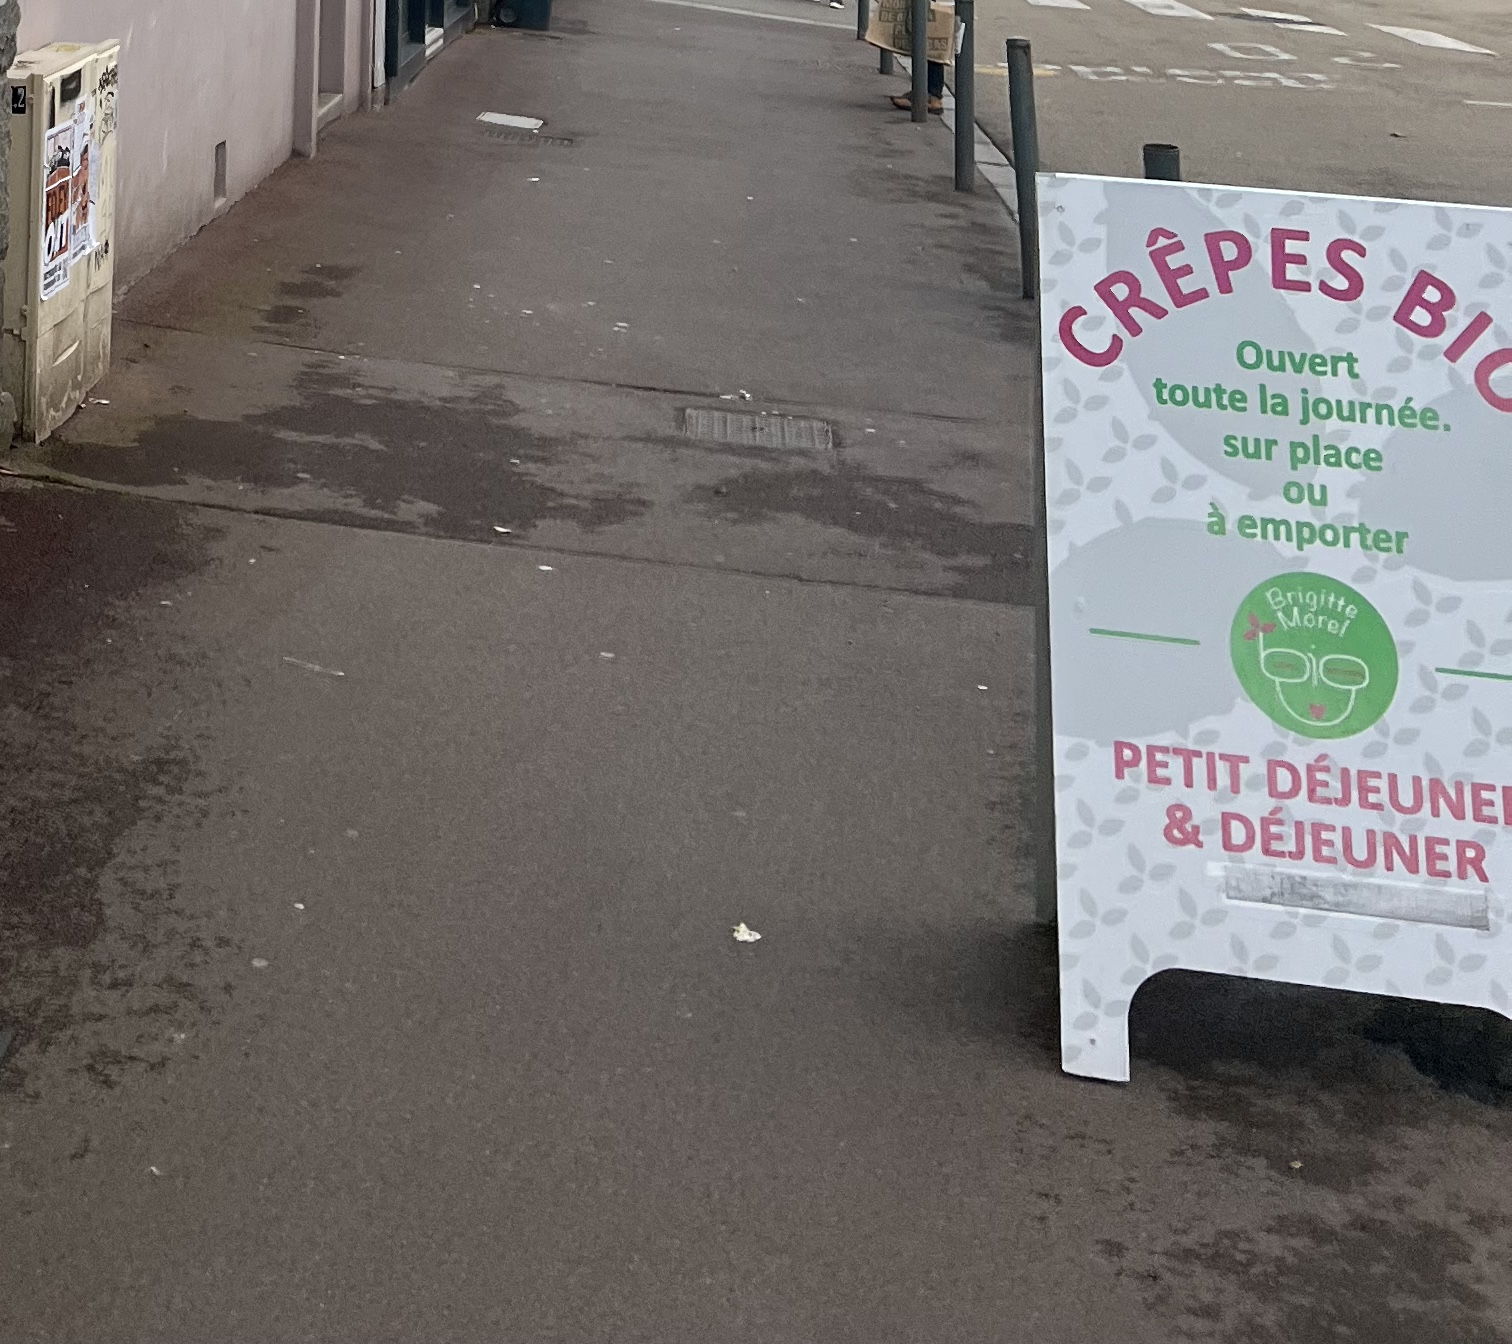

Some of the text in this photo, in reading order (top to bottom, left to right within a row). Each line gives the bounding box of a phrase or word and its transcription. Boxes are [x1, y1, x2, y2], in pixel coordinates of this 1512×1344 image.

[1058, 227, 1367, 368] CRÊPES
[1236, 340, 1360, 380] Ouvert
[1153, 378, 1451, 432] toute la journée.
[1223, 433, 1384, 473] sur place
[1282, 480, 1329, 508] ou
[1207, 502, 1409, 555] à emporter
[1265, 586, 1358, 619] Brigitte
[1276, 606, 1351, 637] Morel
[1113, 740, 1250, 796] PETIT
[1163, 803, 1490, 884] & DÉJEUNER
